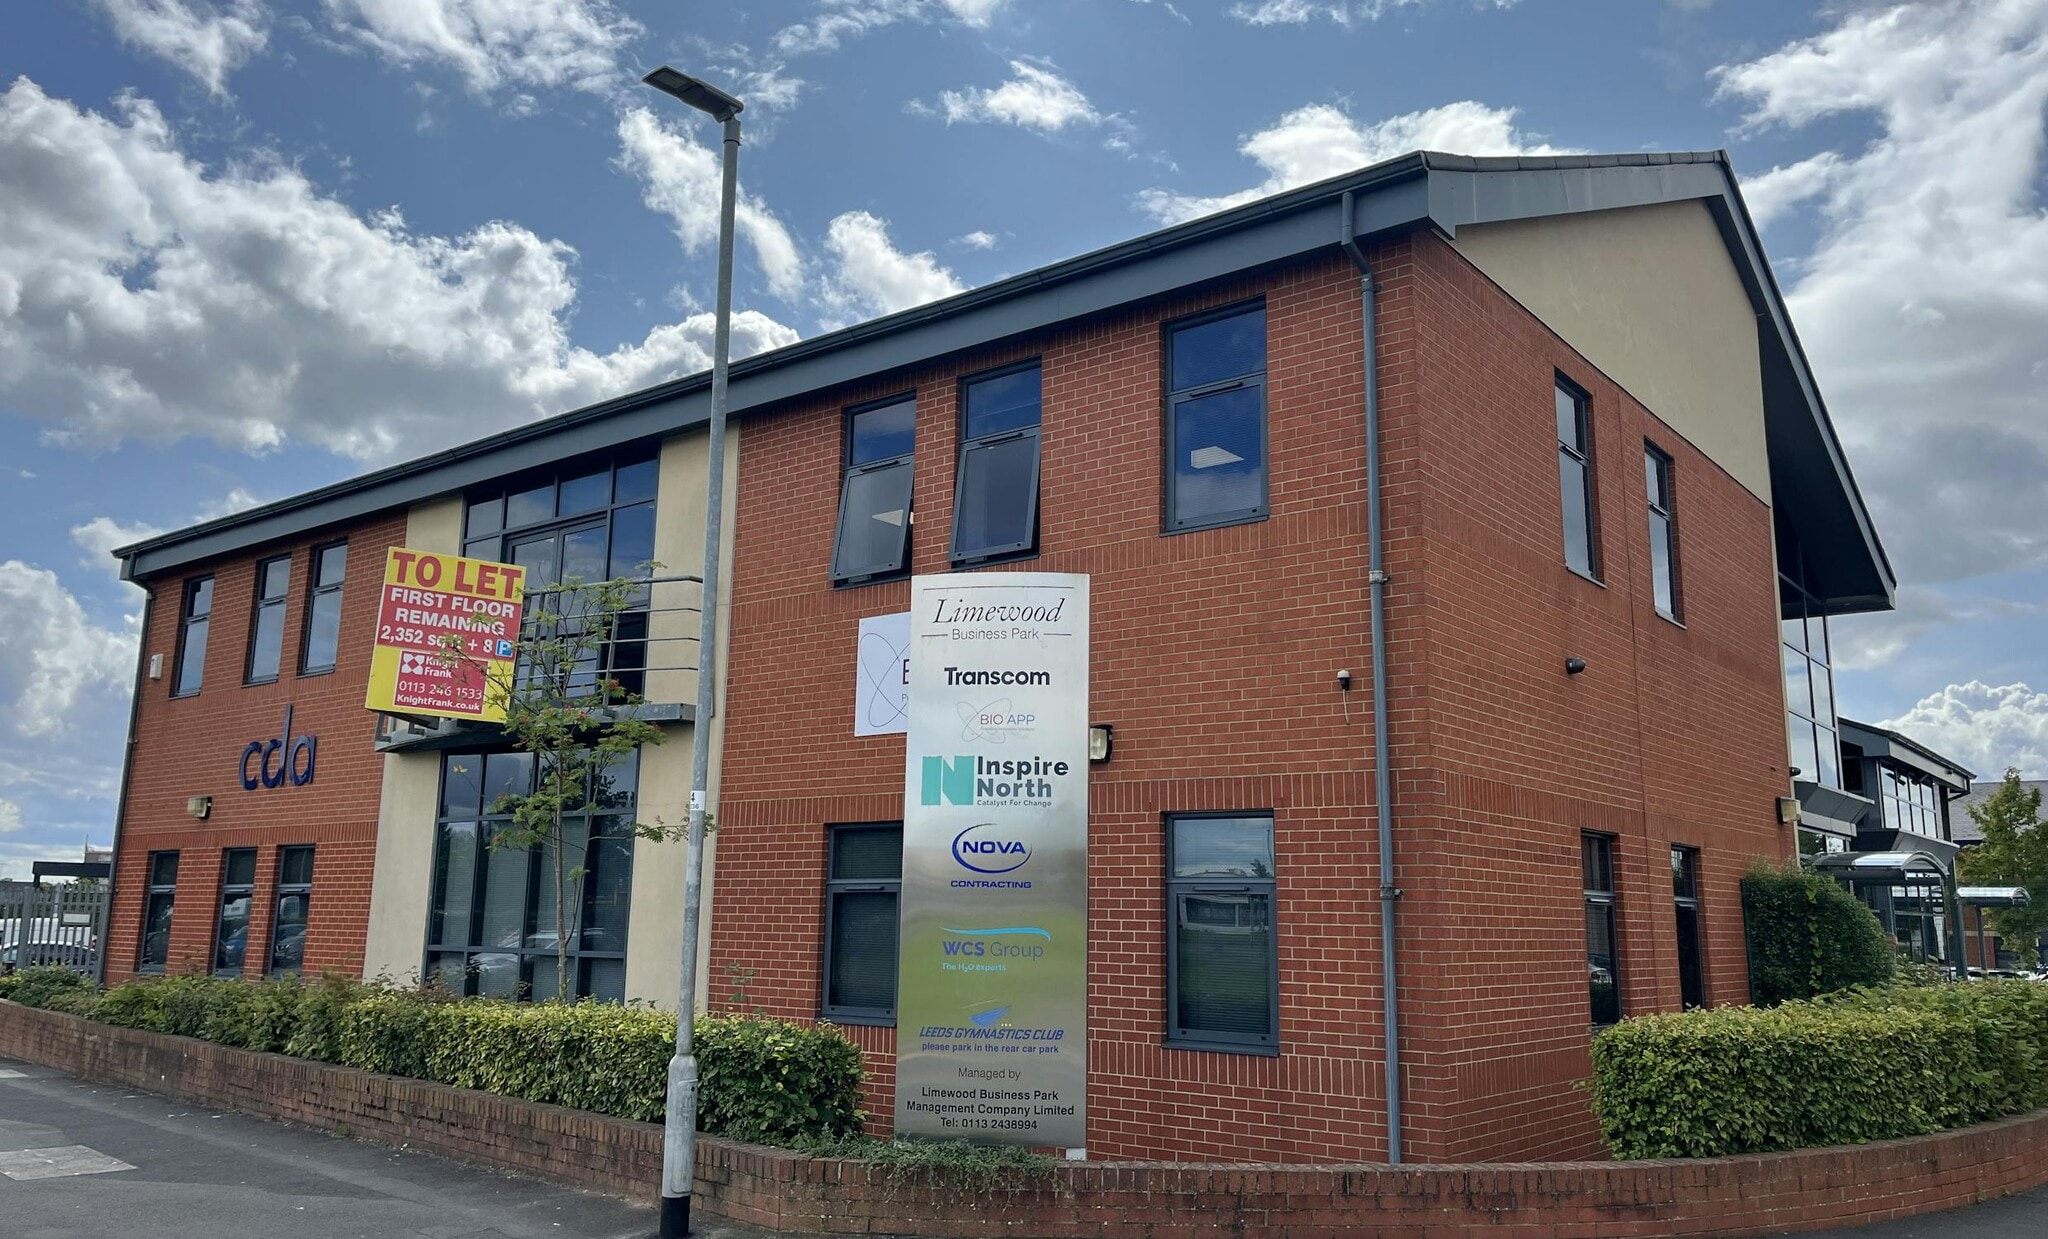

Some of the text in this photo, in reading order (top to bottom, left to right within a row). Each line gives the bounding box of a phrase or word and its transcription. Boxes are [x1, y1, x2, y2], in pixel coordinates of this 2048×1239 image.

[393, 551, 522, 599] TO LET
[391, 587, 515, 618] FIRST FLOOR
[932, 598, 1065, 624] Limewood
[395, 607, 505, 636] REMAINING
[380, 625, 424, 644] 2,352
[483, 639, 493, 653] 8
[952, 627, 1039, 640] Business Park
[424, 666, 452, 678] Frank
[944, 666, 1050, 686] Transcom
[400, 680, 482, 700] 0113 246 1533
[397, 694, 480, 711] KnightFrank.co.uk
[980, 714, 1035, 725] BIO APP
[239, 703, 317, 790] cda
[977, 756, 1069, 780] Inspire
[977, 778, 1052, 798] North
[977, 799, 1007, 807] Catalyst
[962, 841, 1026, 854] NOVA
[950, 880, 1032, 889] CONTRACTING
[942, 941, 1044, 961] WCS Group
[942, 962, 957, 970] The
[975, 963, 1006, 972] experts
[919, 1027, 1064, 1040] LEEDS GYMNASTICS CLUB
[922, 1042, 949, 1052] please
[952, 1043, 972, 1053] park
[974, 1043, 982, 1051] in
[985, 1043, 999, 1052] the
[1001, 1045, 1019, 1053] rear
[1039, 1045, 1059, 1055] park
[958, 1067, 1021, 1081] Managed by
[921, 1087, 1059, 1101] Limewood Business Park
[906, 1101, 1074, 1117] Management Company Limited
[941, 1117, 1037, 1130] Tel: 0113 2438994
